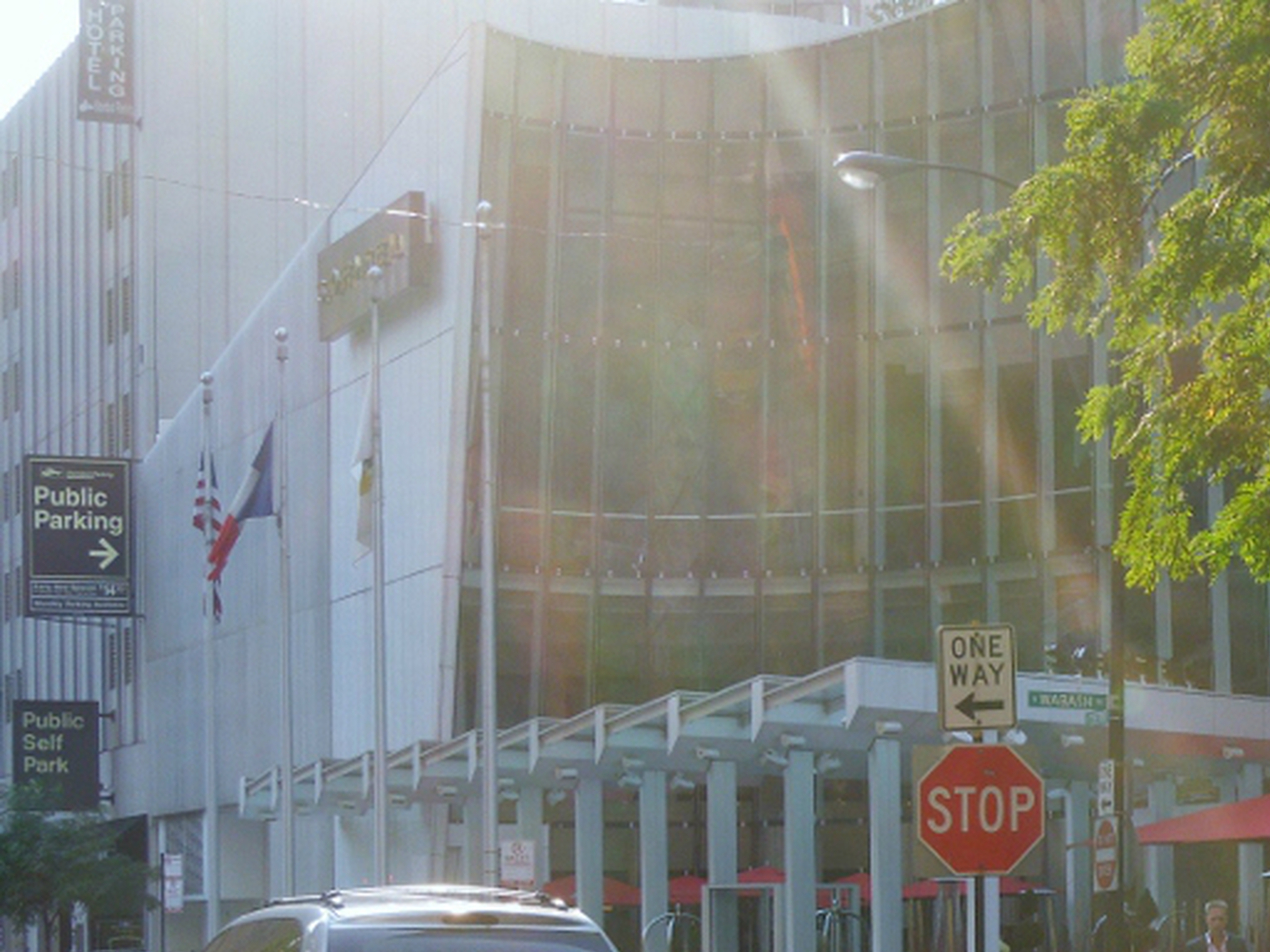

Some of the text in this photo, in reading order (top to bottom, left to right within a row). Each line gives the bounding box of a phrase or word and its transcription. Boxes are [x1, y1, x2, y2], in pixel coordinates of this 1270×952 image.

[86, 8, 103, 90] HOTEL
[108, 4, 125, 97] PARKING
[34, 486, 108, 507] Public
[34, 510, 123, 536] Parking
[951, 634, 1004, 660] ONE
[949, 662, 1005, 686] WAY
[1040, 693, 1094, 710] WABASH
[23, 711, 86, 730] Public
[23, 733, 64, 751] Self
[23, 756, 69, 774] Park
[927, 786, 1035, 834] STOP
